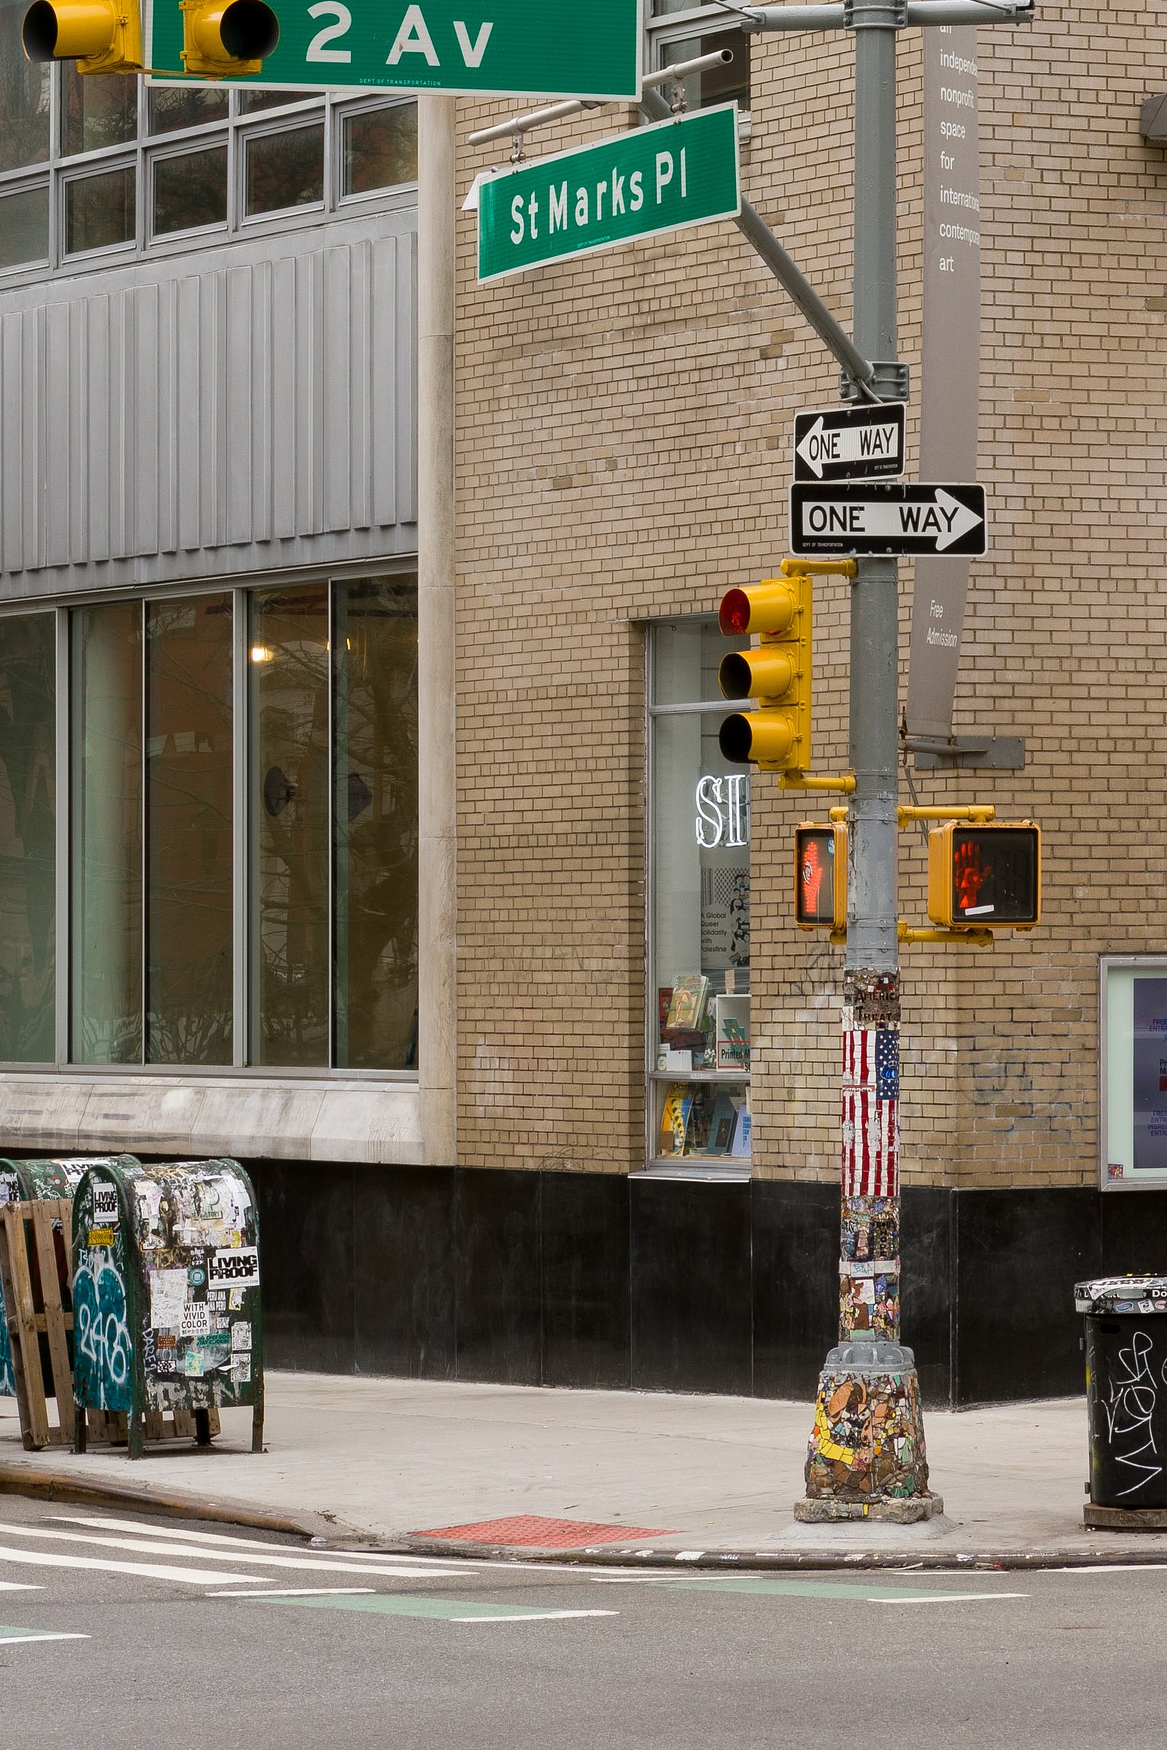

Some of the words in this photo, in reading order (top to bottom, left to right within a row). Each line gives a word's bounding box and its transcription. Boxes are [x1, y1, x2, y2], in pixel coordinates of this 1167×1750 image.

[305, 0, 352, 64] 2
[385, 4, 494, 68] Av
[939, 49, 978, 78] independe
[940, 86, 975, 110] nonprofit
[940, 120, 966, 139] space
[939, 150, 955, 171] for
[509, 190, 539, 246] St
[548, 166, 644, 234] Marks
[655, 146, 687, 205] Pl
[939, 184, 980, 213] internationa
[938, 222, 981, 247] contempora
[938, 255, 955, 273] art
[808, 432, 841, 462] ONE
[859, 426, 895, 457] WAY
[808, 505, 866, 533] ONE
[898, 506, 960, 533] WAY
[929, 599, 944, 619] Free
[925, 626, 958, 648] Admission
[695, 774, 748, 848] SI
[701, 929, 728, 937] olidarity
[94, 1191, 117, 1203] LIVING
[94, 1202, 118, 1213] PROOF
[209, 1254, 258, 1269] LIVING
[209, 1266, 258, 1280] PROOF
[183, 1303, 204, 1312] WITH
[183, 1311, 206, 1320] VIVID
[181, 1319, 208, 1329] COLOR
